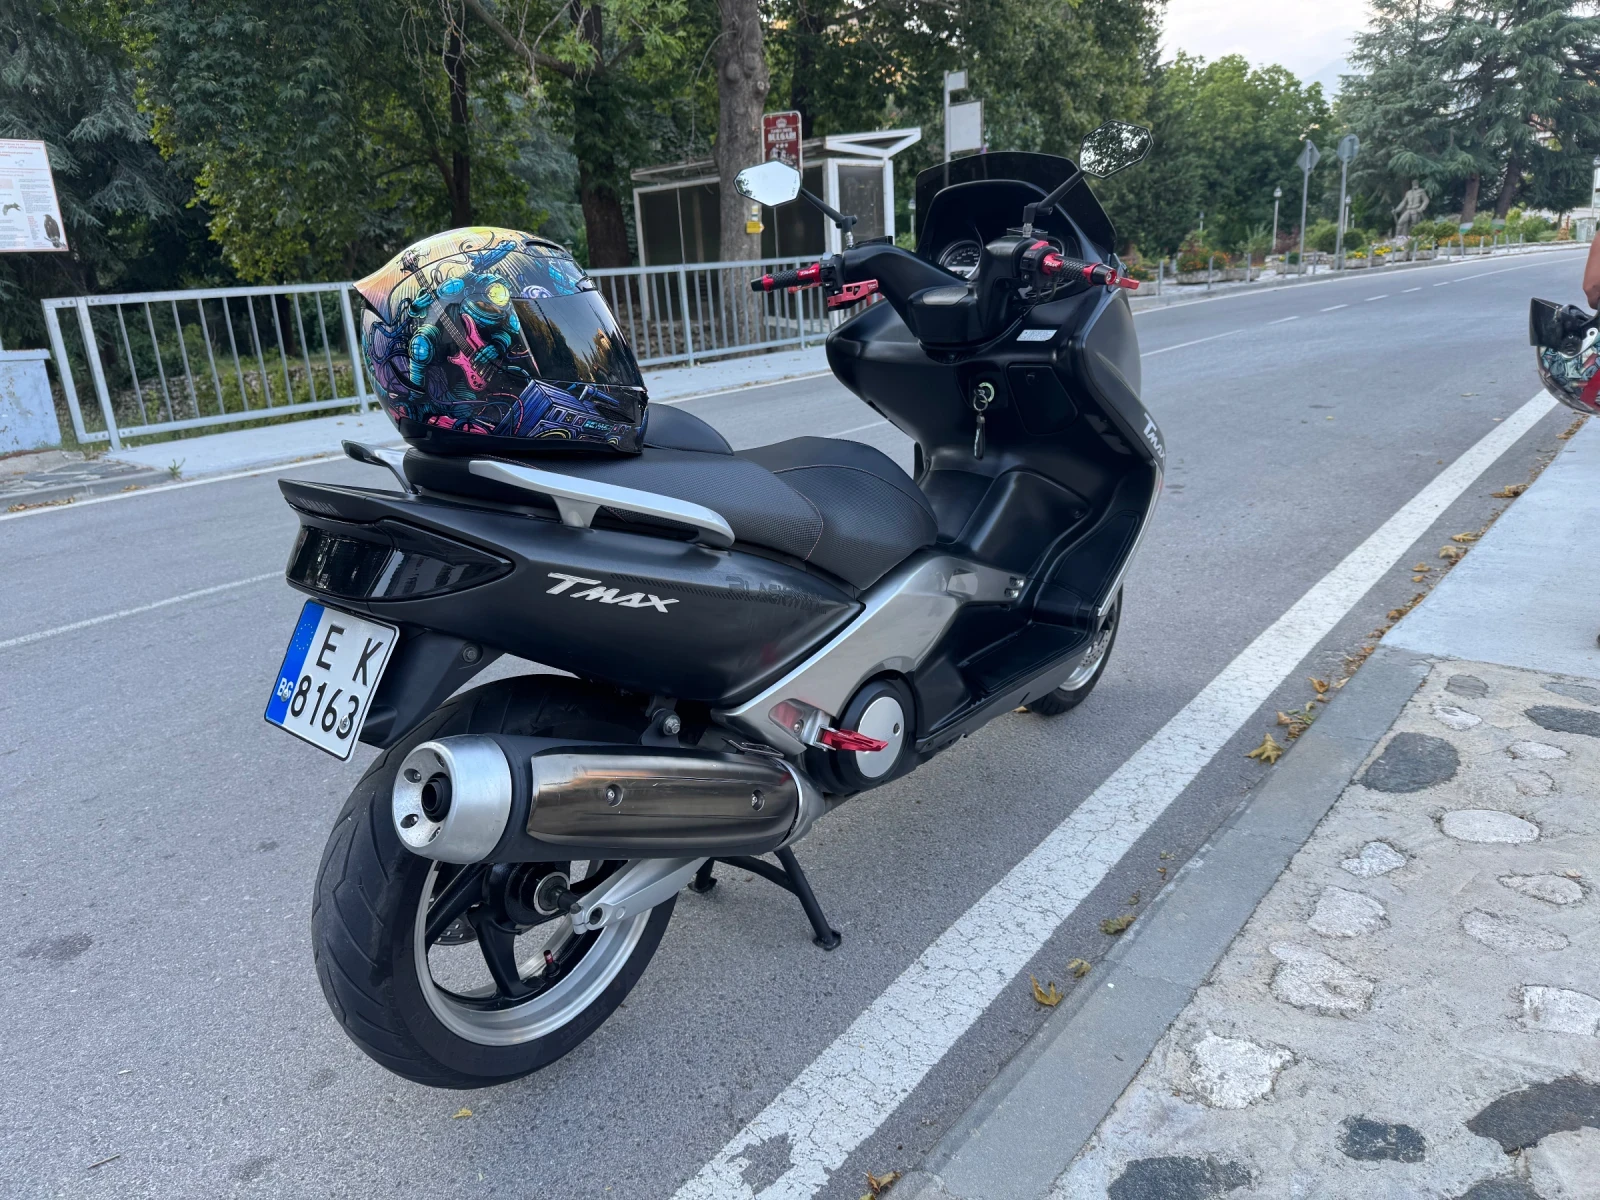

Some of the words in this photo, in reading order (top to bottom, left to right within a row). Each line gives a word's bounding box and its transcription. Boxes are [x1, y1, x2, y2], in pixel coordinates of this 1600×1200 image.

[545, 572, 680, 613] TMAX
[276, 677, 294, 699] BG
[290, 674, 360, 740] 8163
